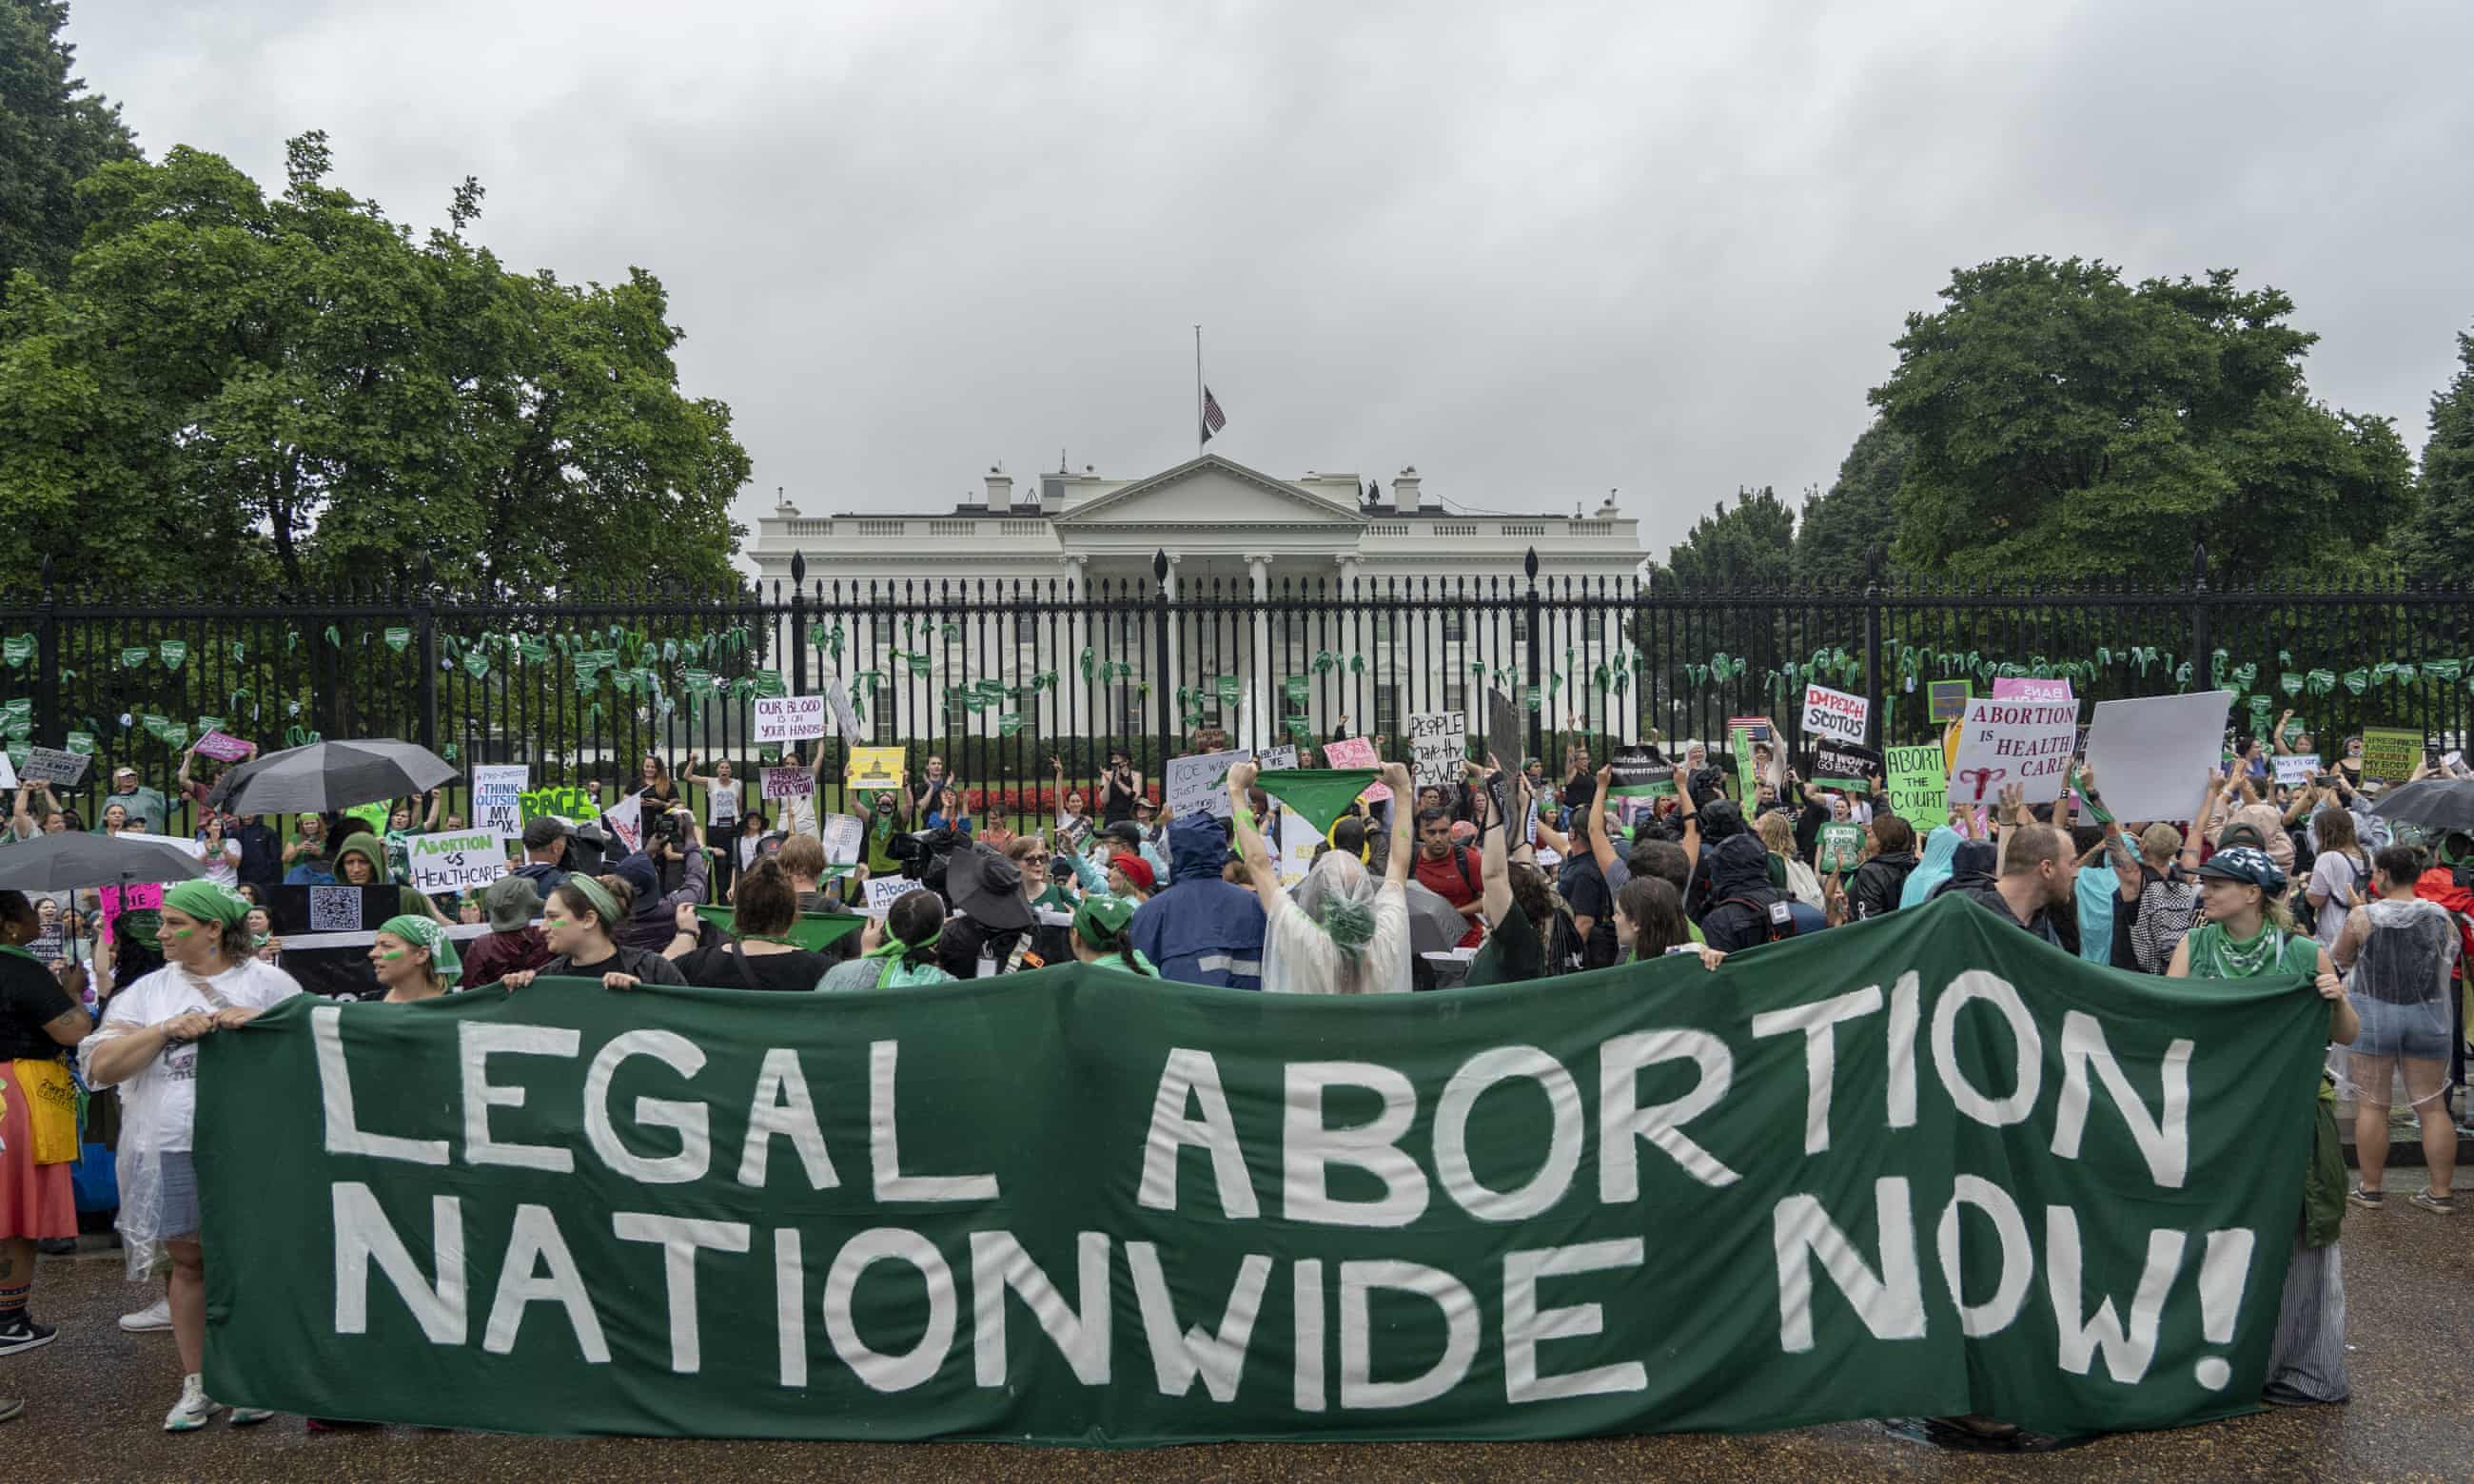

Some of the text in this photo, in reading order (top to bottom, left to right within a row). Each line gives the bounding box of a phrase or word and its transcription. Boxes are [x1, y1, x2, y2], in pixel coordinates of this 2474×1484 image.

[758, 700, 820, 715] OUR BLOOD
[1808, 689, 1865, 719] IMPEACH
[776, 714, 786, 723] IS
[1809, 708, 1864, 737] SCOTUS
[1971, 705, 2076, 725] ABORTION
[761, 725, 785, 737] YOUR
[1411, 713, 1463, 737] PEOPLE
[1979, 730, 1994, 742] IS
[1994, 735, 2072, 757] HEALTH
[1269, 756, 1284, 767] WE
[1819, 750, 1835, 762] WE
[1887, 748, 1941, 773] ABORT
[1817, 760, 1861, 776] GO BACK
[2020, 756, 2067, 777] CARE
[2364, 760, 2409, 770] MY BODY
[1174, 763, 1204, 785] ROE
[1903, 776, 1929, 788] THE
[483, 783, 519, 794] THINK
[1171, 784, 1199, 800] JUST
[476, 794, 520, 807] OUTSID
[1891, 791, 1946, 810] COURT
[490, 806, 511, 818] MY
[412, 835, 493, 857] ABORTION
[414, 865, 504, 889] HEALTHCARE
[310, 968, 2195, 1228] LEGAL ABORTION
[330, 1173, 2255, 1413] NATIONWIDE NOW!
